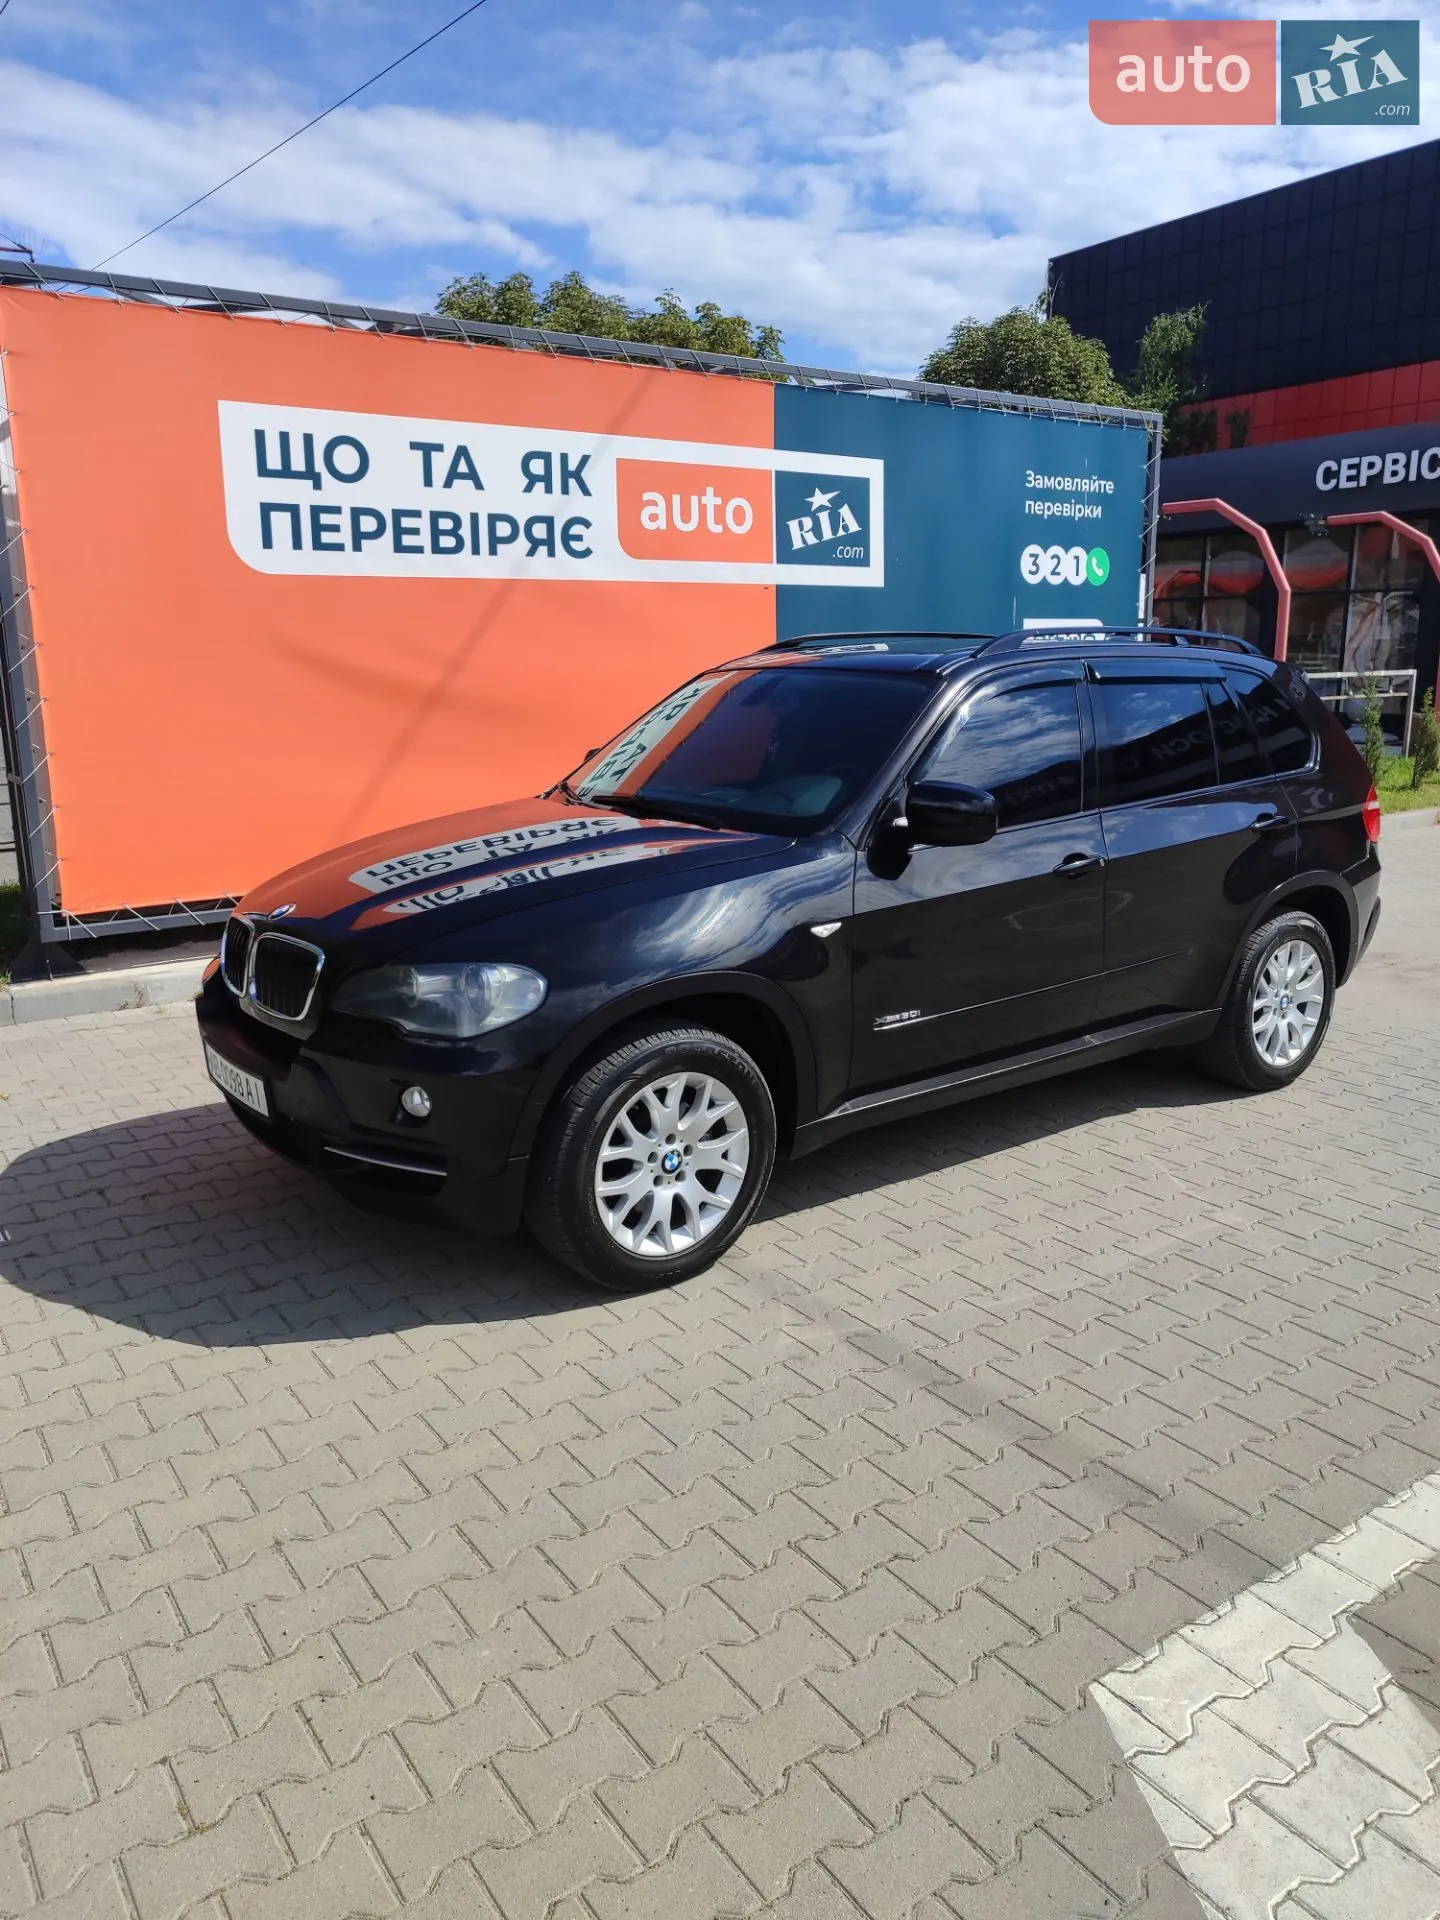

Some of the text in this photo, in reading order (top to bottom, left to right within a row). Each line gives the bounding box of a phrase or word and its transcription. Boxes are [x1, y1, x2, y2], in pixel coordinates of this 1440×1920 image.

[254, 428, 593, 497] ЩО ТА ЯК
[1025, 469, 1115, 495] Замовляйте
[1315, 446, 1440, 492] СЕРВІС
[259, 501, 594, 560] ПЕРЕВІРЯЄ
[640, 486, 863, 551] auto RIA
[1025, 498, 1102, 521] перевірки
[832, 544, 865, 560] .com
